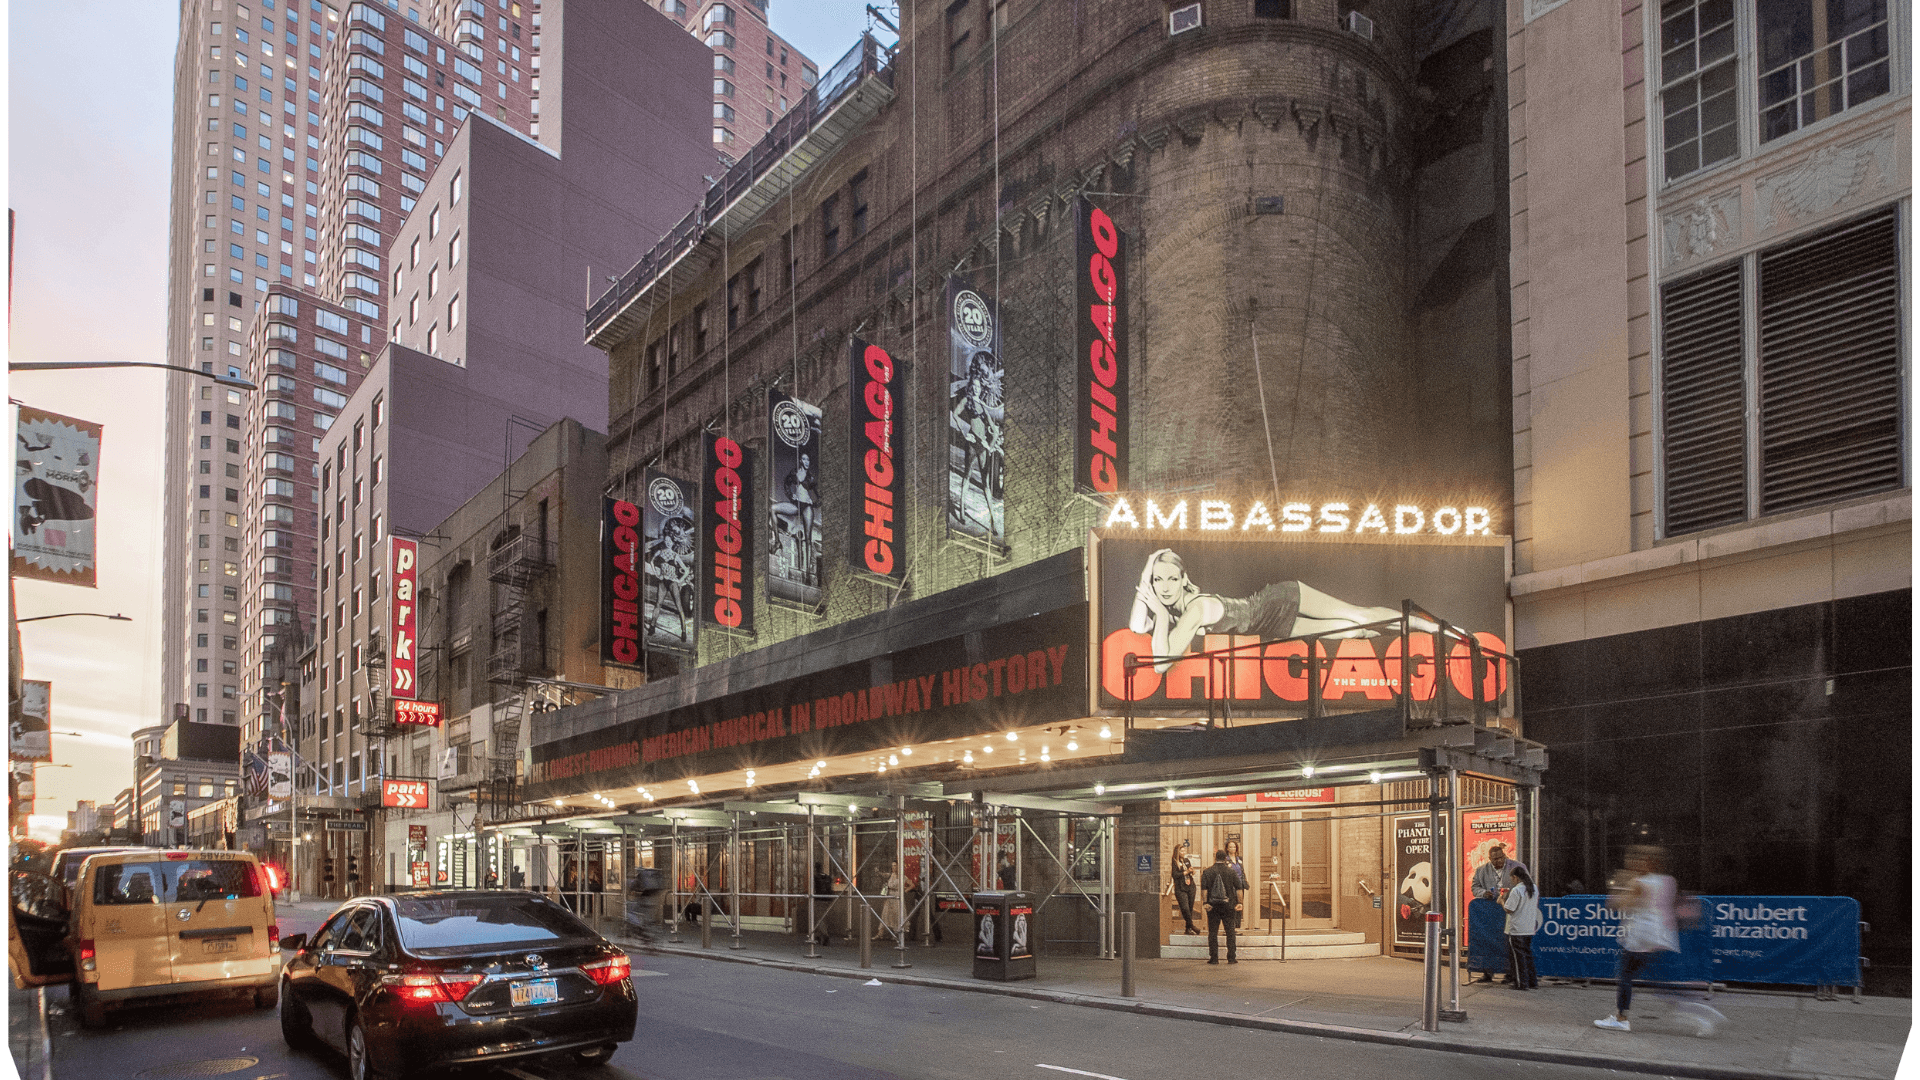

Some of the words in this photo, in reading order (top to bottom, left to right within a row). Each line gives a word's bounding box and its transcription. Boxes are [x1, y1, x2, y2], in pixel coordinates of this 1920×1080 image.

[963, 306, 983, 326] 20
[965, 324, 984, 333] YEARS
[1090, 208, 1118, 493] CHICAGO
[781, 413, 802, 430] 20
[784, 426, 803, 437] YEARS
[864, 344, 894, 575] CHICAGO
[657, 488, 674, 502] 20
[660, 498, 676, 507] YEARS
[1105, 496, 1492, 536] AMBASSADOR
[714, 437, 743, 628] CHICAGO
[612, 499, 640, 665] CHICAGO
[395, 547, 414, 660] park
[1102, 628, 1507, 702] CHICAGO
[1333, 677, 1357, 687] THE
[1360, 678, 1415, 687] MUSIC
[397, 700, 410, 711] 24
[412, 703, 437, 714] hours
[545, 740, 640, 782] LONGEST-RUNNING
[642, 724, 711, 763] AMERICAN
[713, 707, 787, 750] MUSICAL
[790, 702, 811, 735] IN
[814, 673, 936, 730] BROADWAY
[942, 644, 1069, 707] HISTORY
[386, 782, 426, 796] park
[1405, 844, 1430, 854] OPER
[1543, 903, 1580, 920] The
[1715, 903, 1808, 921] Shubert
